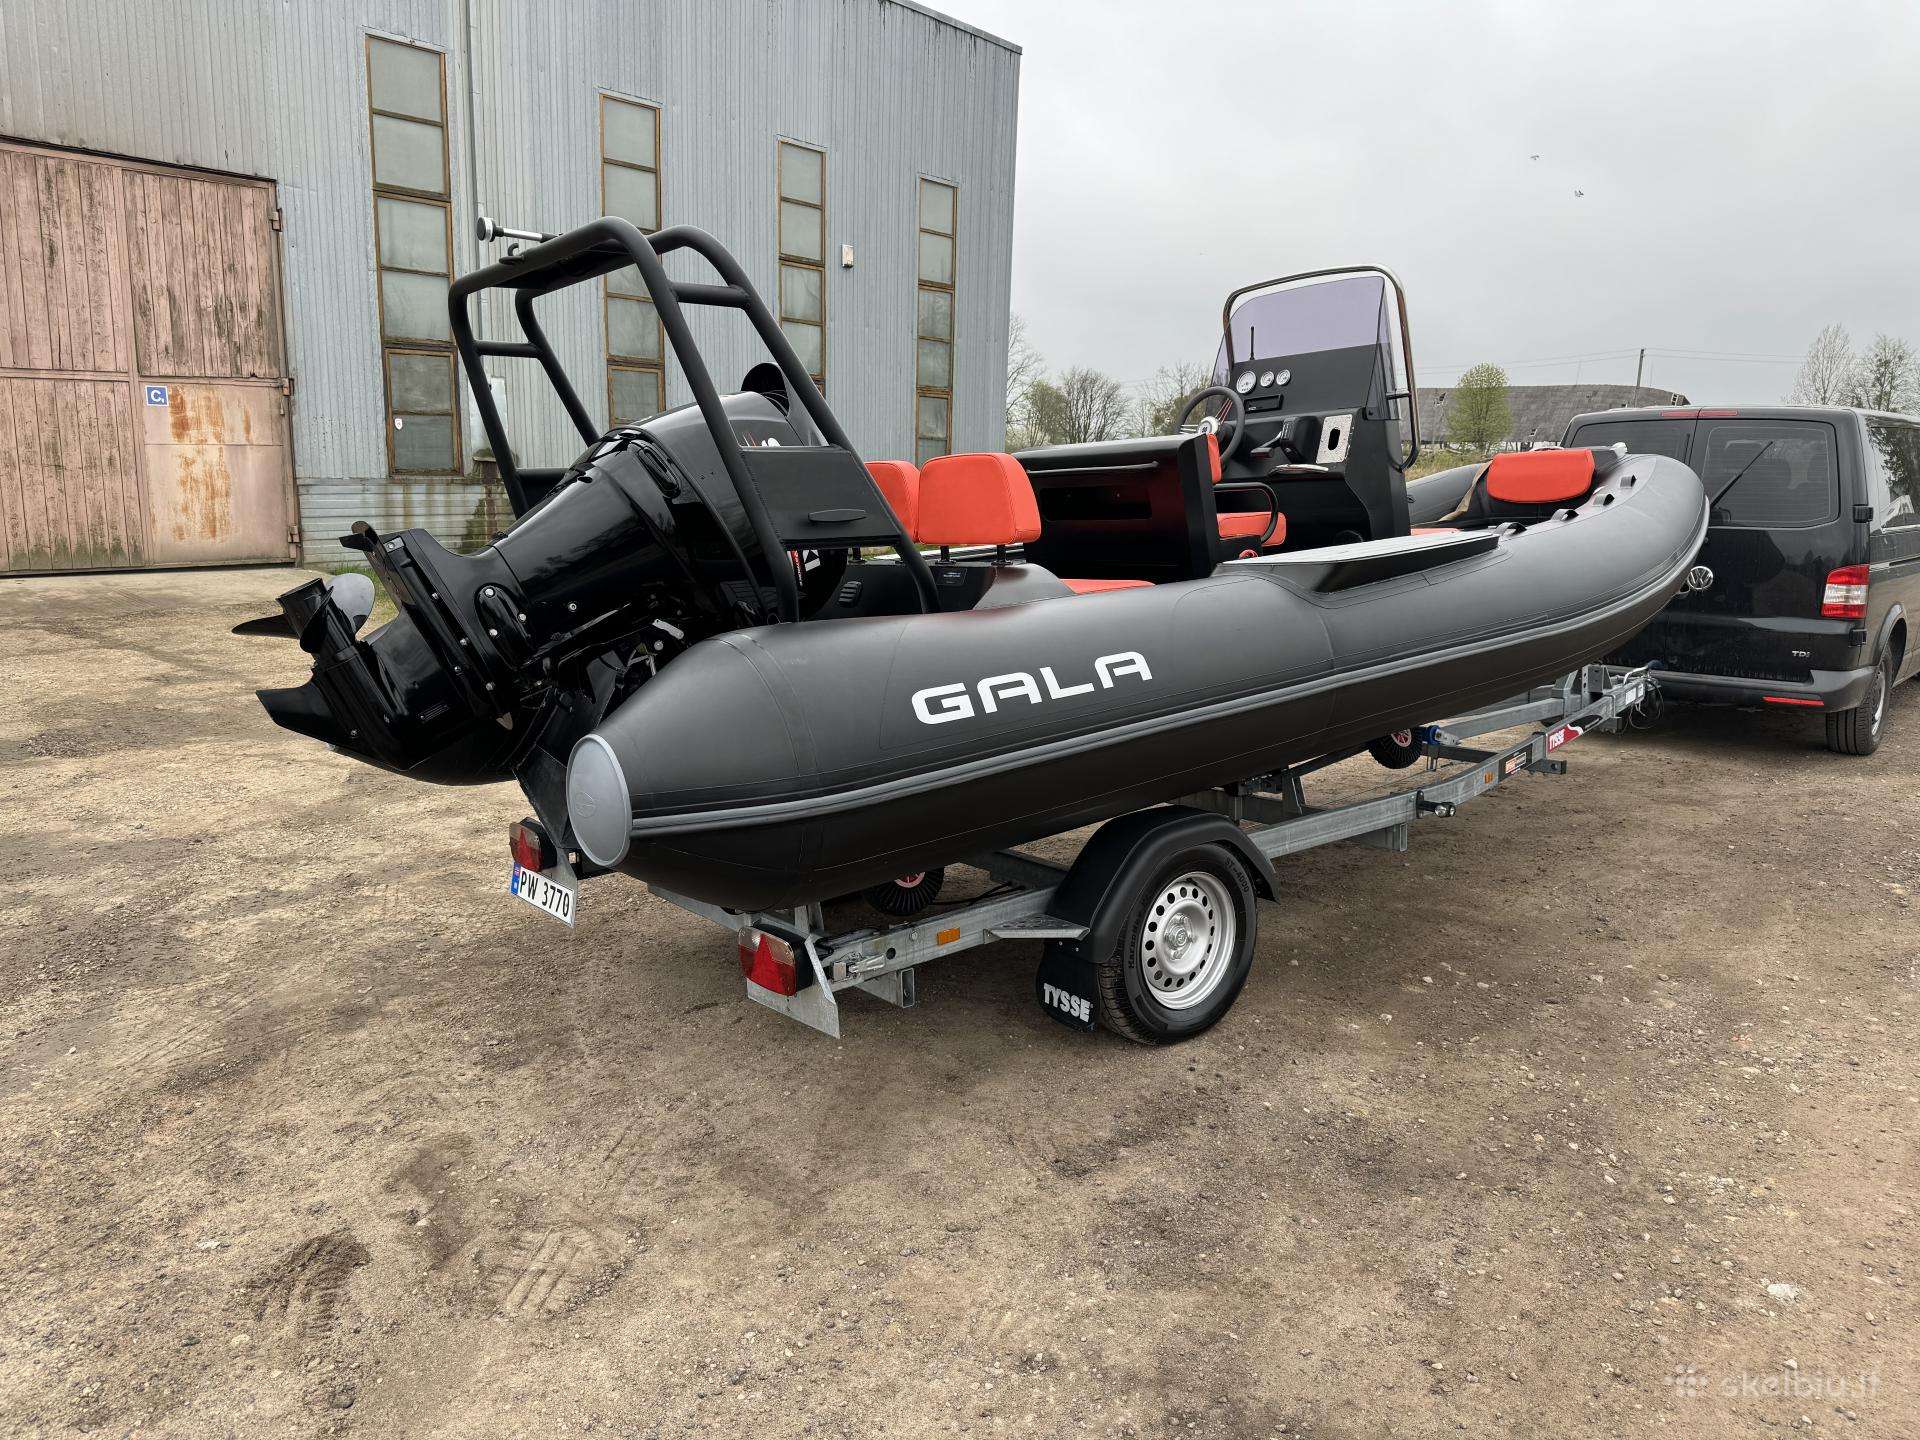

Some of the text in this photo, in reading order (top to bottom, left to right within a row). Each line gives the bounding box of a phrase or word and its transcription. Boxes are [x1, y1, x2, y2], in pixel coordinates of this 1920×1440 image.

[1687, 566, 1713, 590] VW
[911, 651, 1153, 725] GALA
[520, 871, 570, 918] PW 3770
[1043, 982, 1091, 1023] TYSSE
